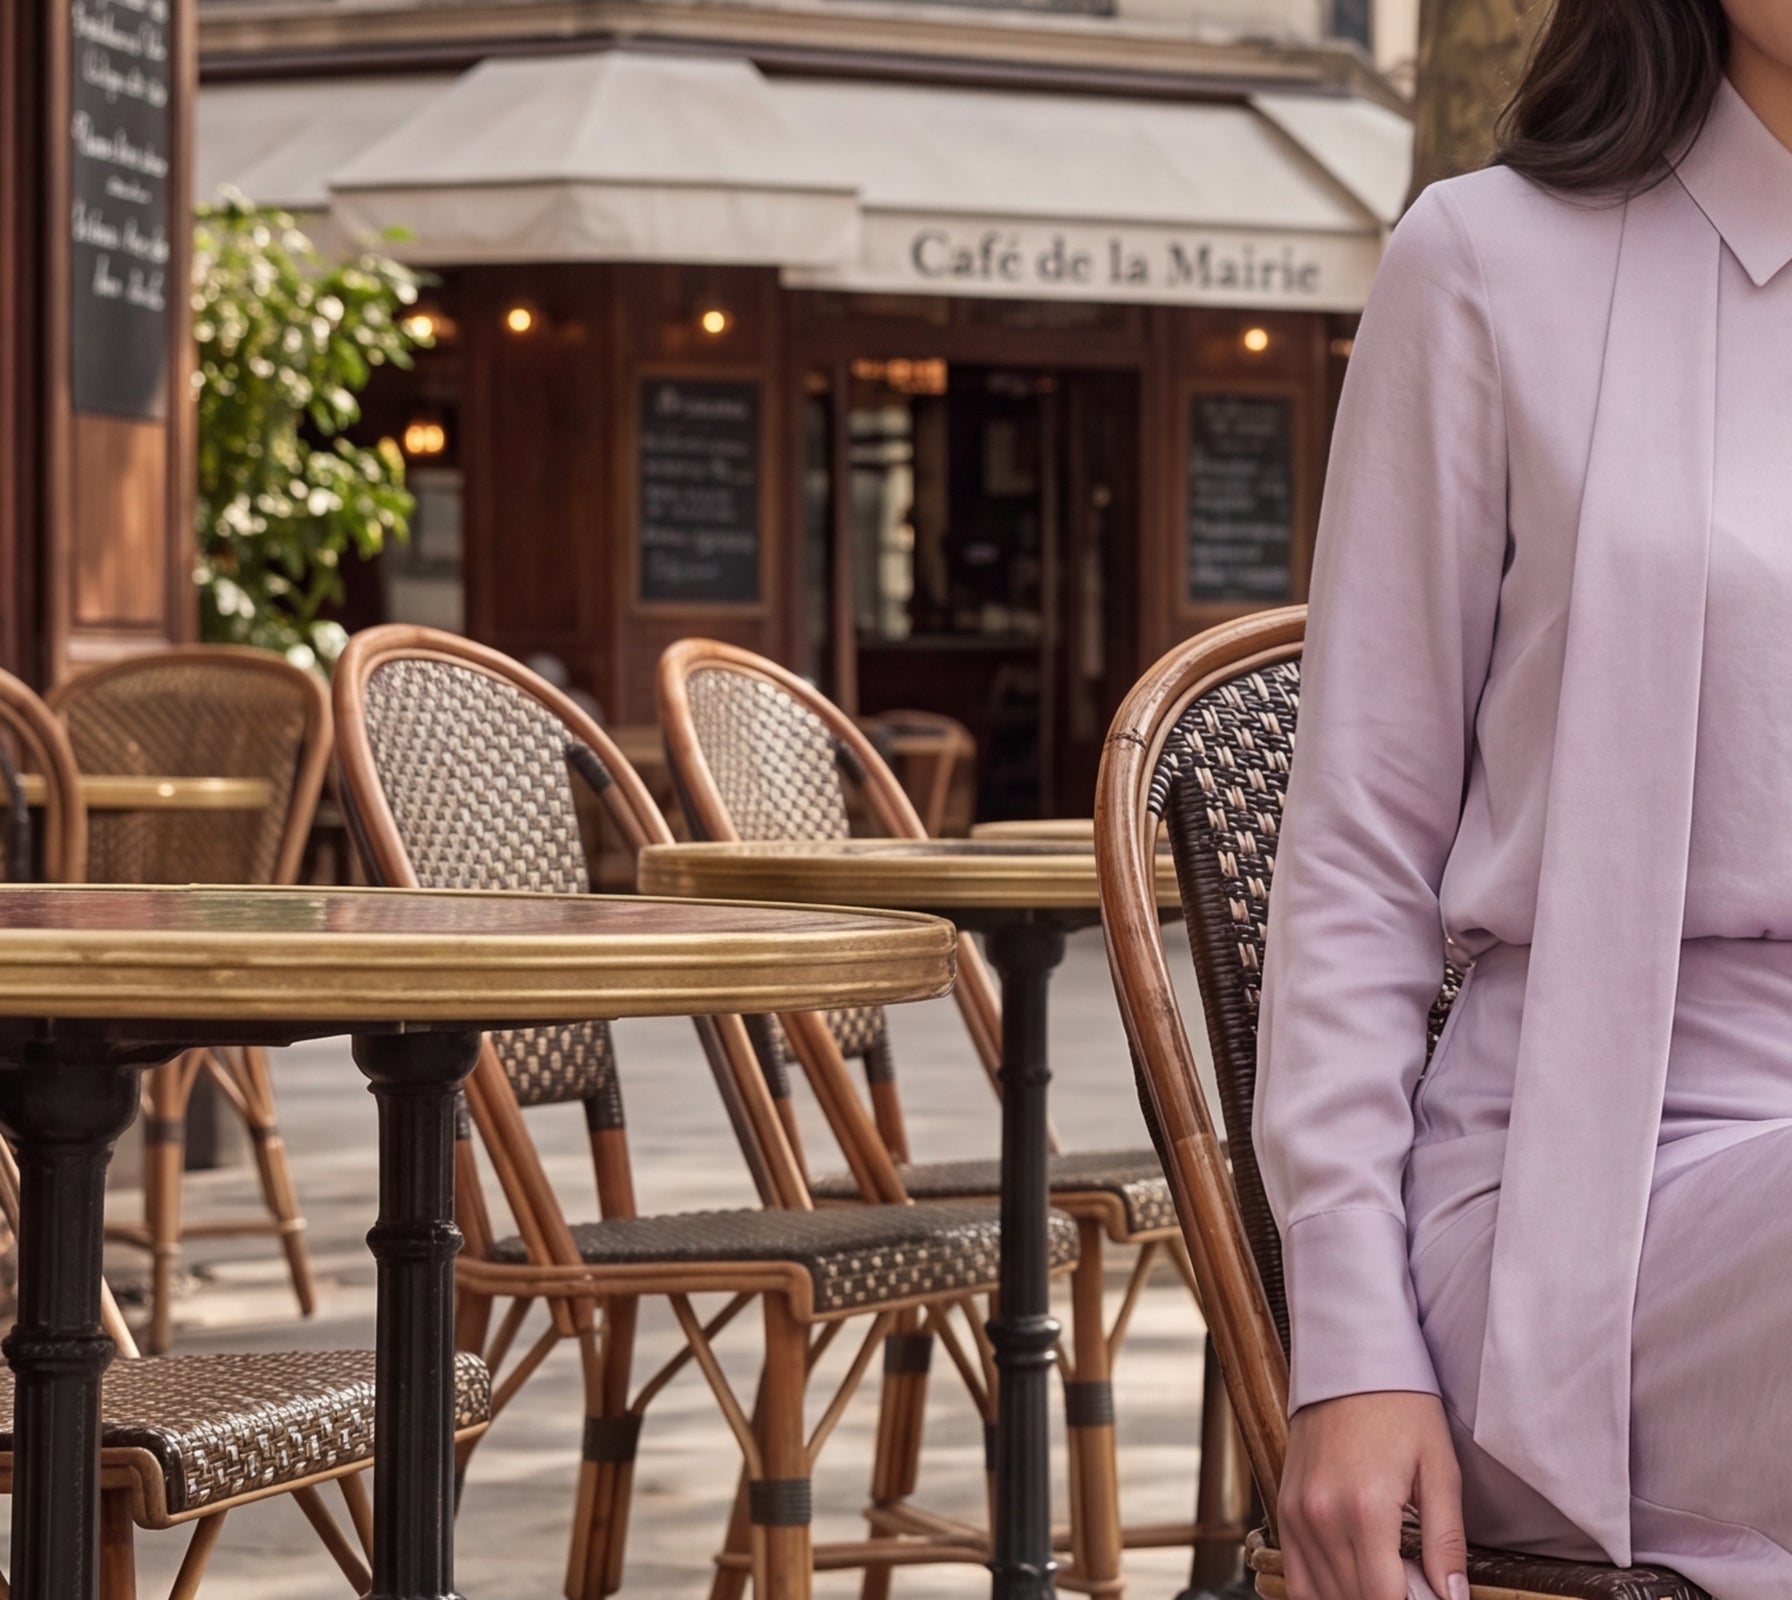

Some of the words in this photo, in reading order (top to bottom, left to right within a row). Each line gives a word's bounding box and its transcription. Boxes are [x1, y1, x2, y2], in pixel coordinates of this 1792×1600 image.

[911, 229, 1023, 281] Café
[1034, 234, 1093, 283] de
[1108, 236, 1149, 286] la
[1167, 238, 1322, 294] Mairie
